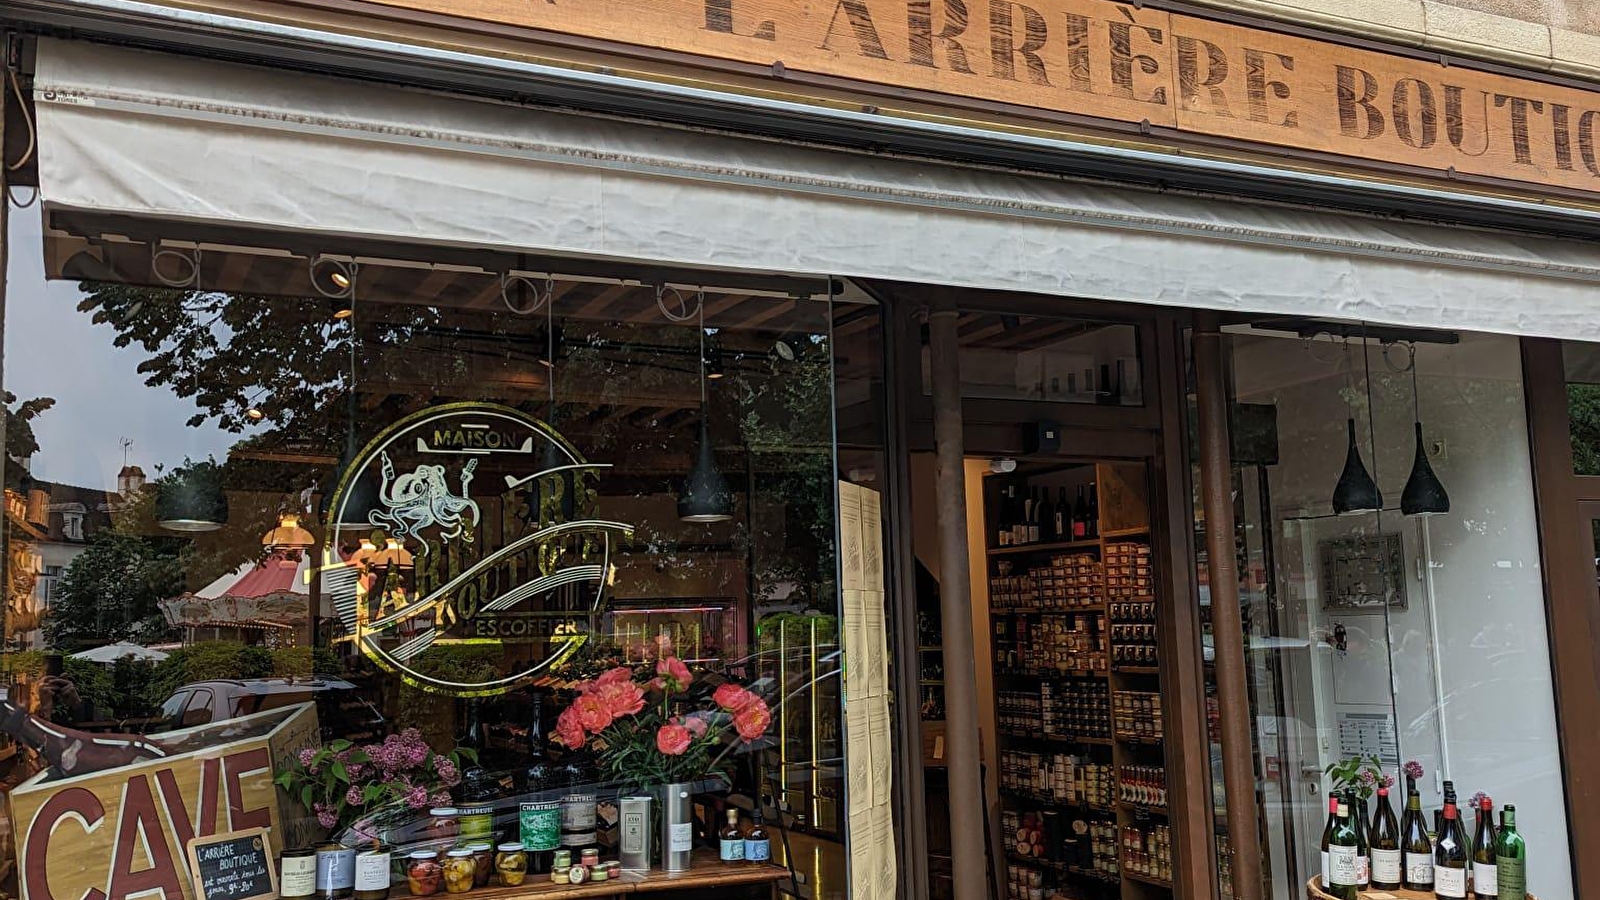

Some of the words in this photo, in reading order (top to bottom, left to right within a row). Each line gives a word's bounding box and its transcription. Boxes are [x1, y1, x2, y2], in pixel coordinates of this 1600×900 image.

[698, 0, 1299, 127] ARRIÈRE
[433, 429, 517, 448] MAISON
[476, 619, 578, 636] ESCOFFER
[458, 806, 494, 816] HARTREUSE
[21, 747, 273, 900] CAVE
[219, 853, 258, 870] BOUTIQUE
